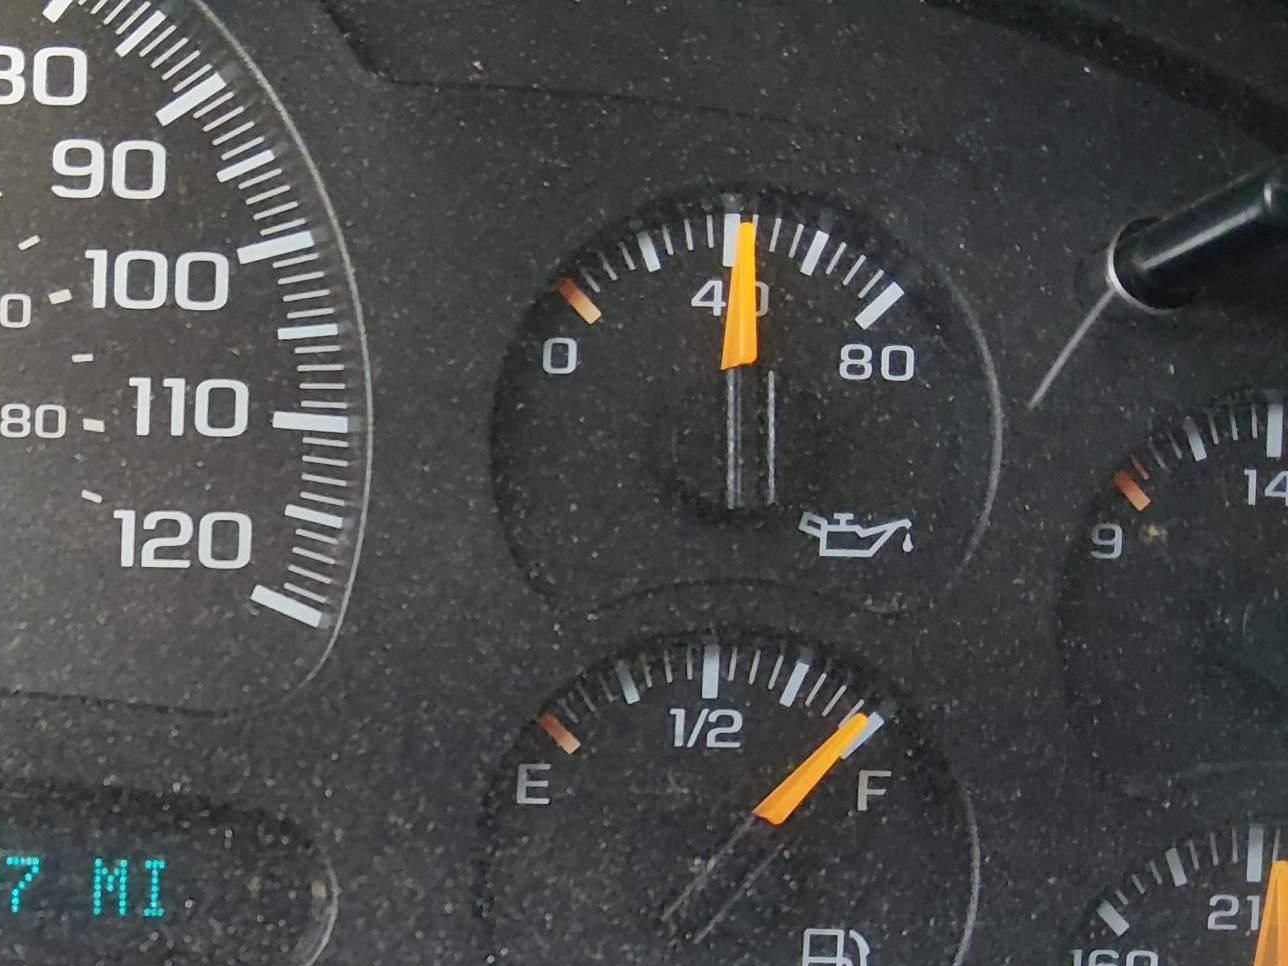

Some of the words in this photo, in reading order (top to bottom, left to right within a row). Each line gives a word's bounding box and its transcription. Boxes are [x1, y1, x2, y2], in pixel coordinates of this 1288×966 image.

[52, 139, 167, 199] 90
[85, 250, 229, 311] 100
[543, 337, 578, 375] 0
[840, 344, 914, 381] 80
[129, 377, 249, 437] 110
[1244, 469, 1288, 506] 14
[114, 510, 252, 569] 120
[1091, 523, 1123, 559] 9
[669, 708, 743, 749] 1/2
[517, 764, 551, 805] E
[857, 770, 891, 811] F
[94, 858, 165, 916] MI
